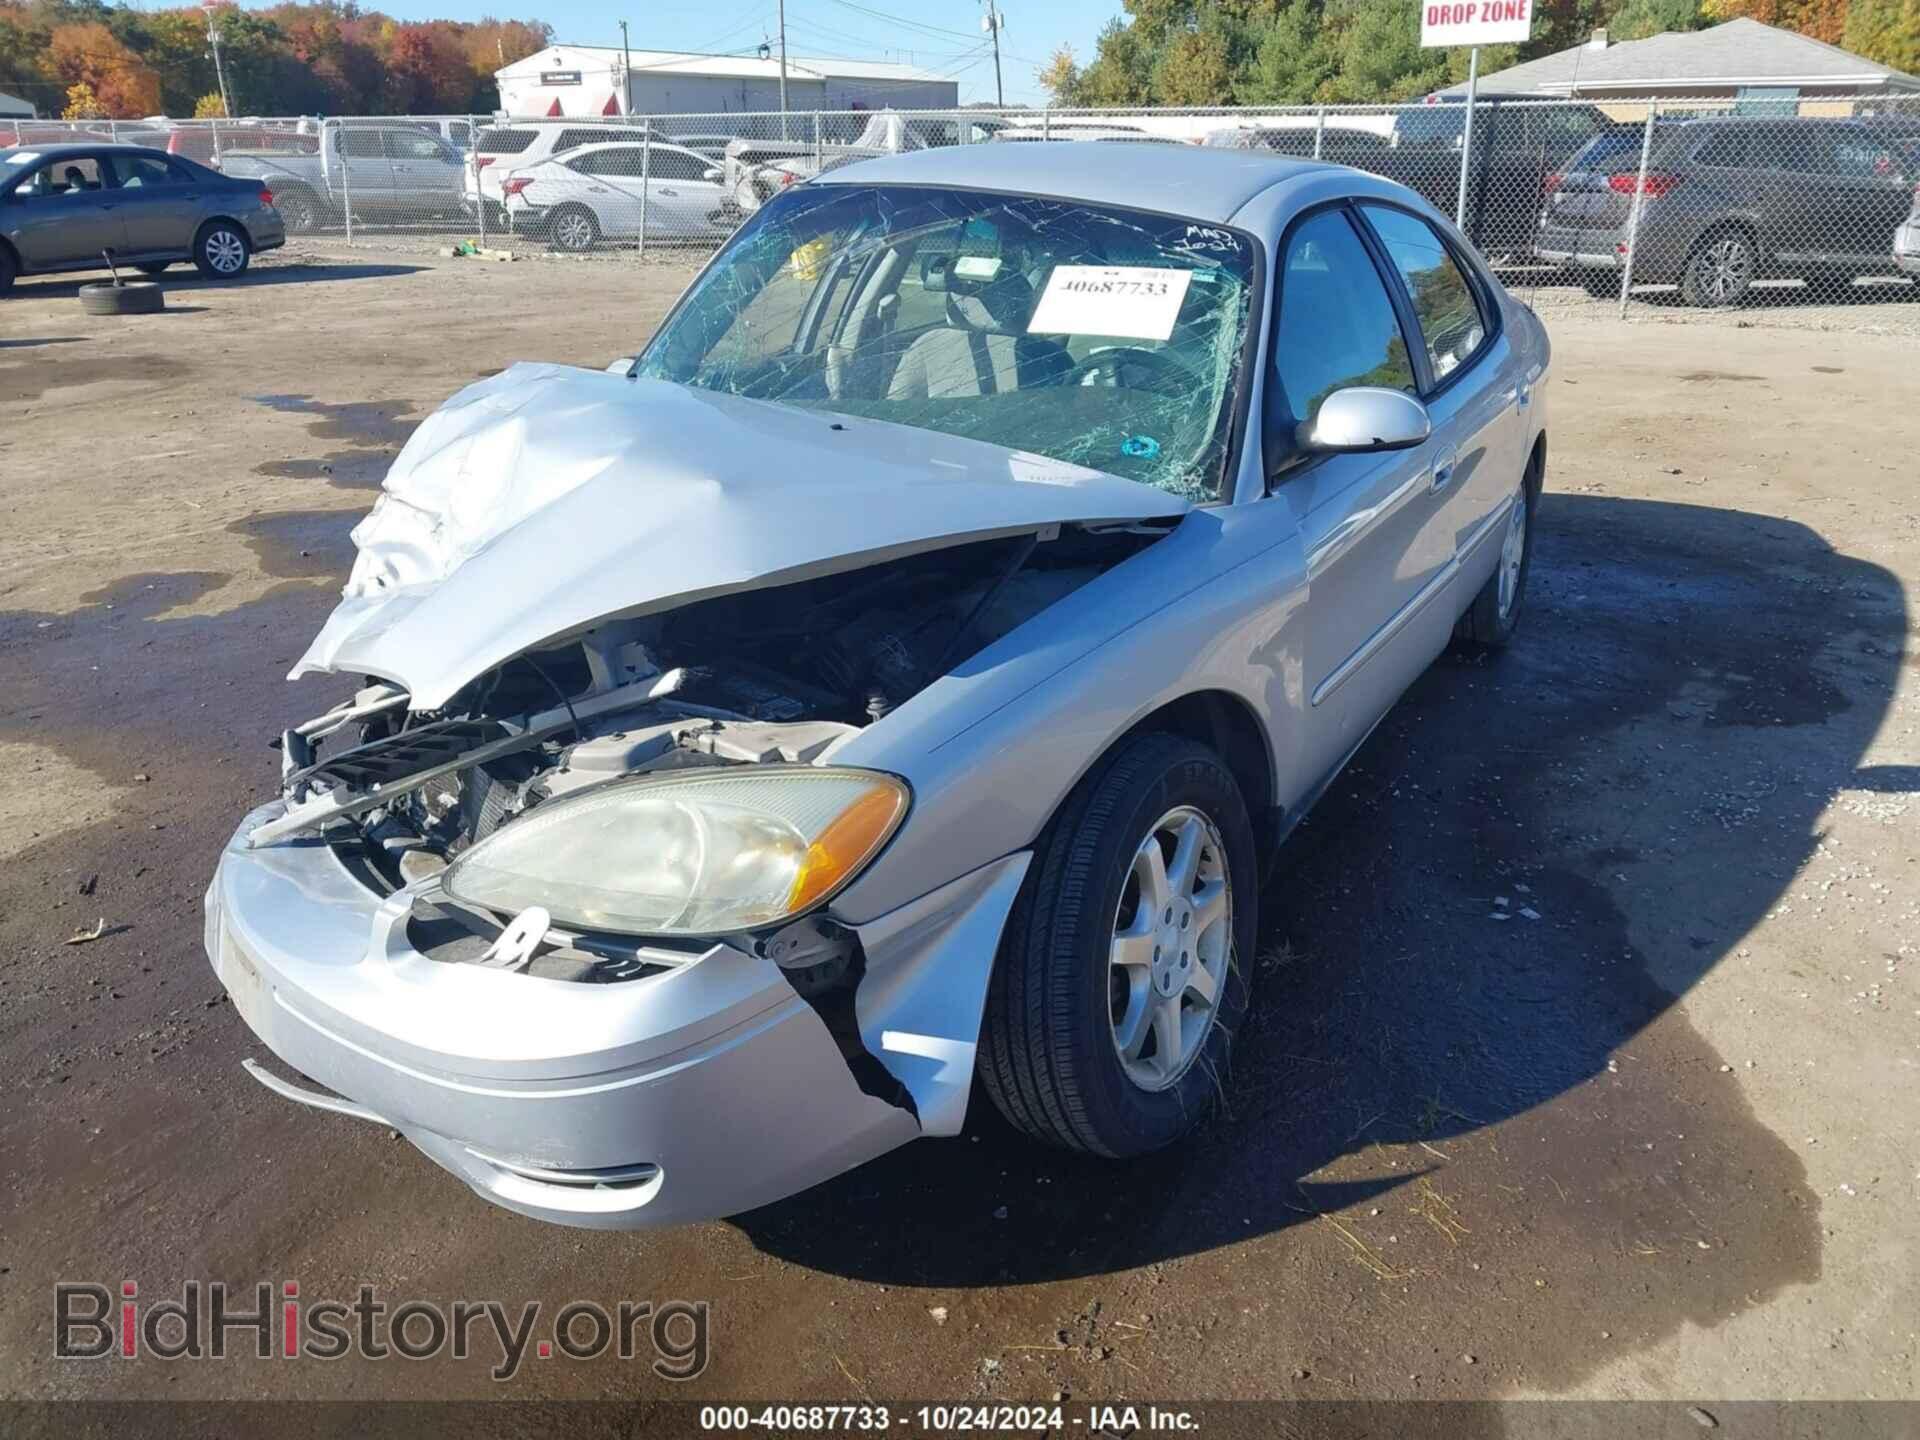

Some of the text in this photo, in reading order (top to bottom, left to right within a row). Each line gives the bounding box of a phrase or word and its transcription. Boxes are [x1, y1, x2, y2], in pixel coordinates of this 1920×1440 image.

[1427, 0, 1526, 26] DROP ZONE
[1060, 280, 1169, 296] 40687733
